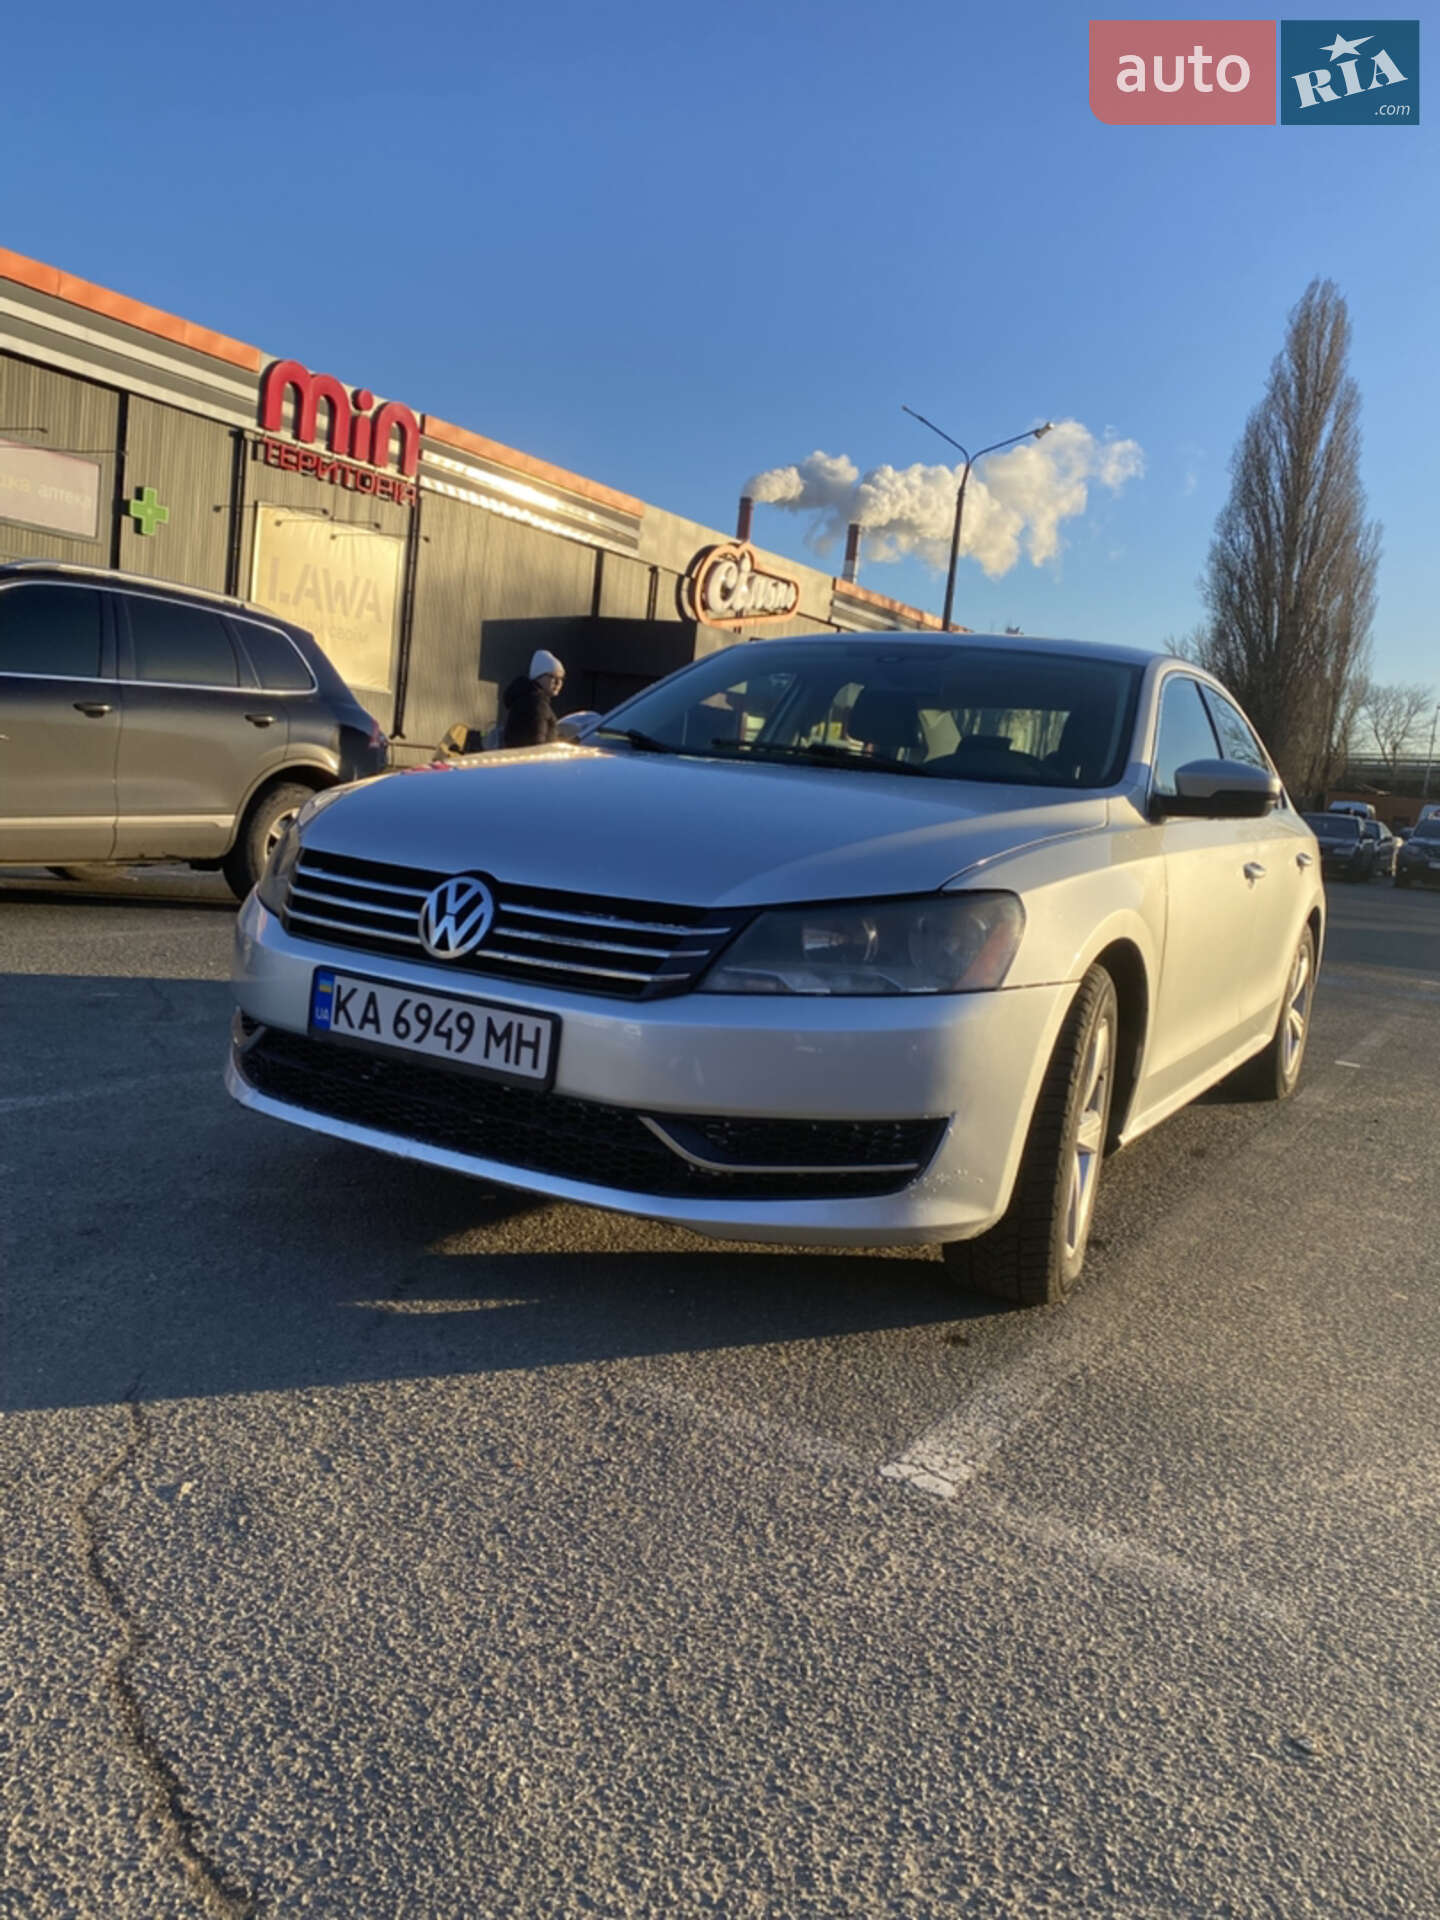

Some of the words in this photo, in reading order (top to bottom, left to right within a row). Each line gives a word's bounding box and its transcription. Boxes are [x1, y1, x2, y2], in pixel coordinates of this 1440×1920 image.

[267, 557, 384, 623] LAWA
[333, 984, 382, 1035] KA
[392, 998, 476, 1054] 6949
[483, 1015, 542, 1071] MH
